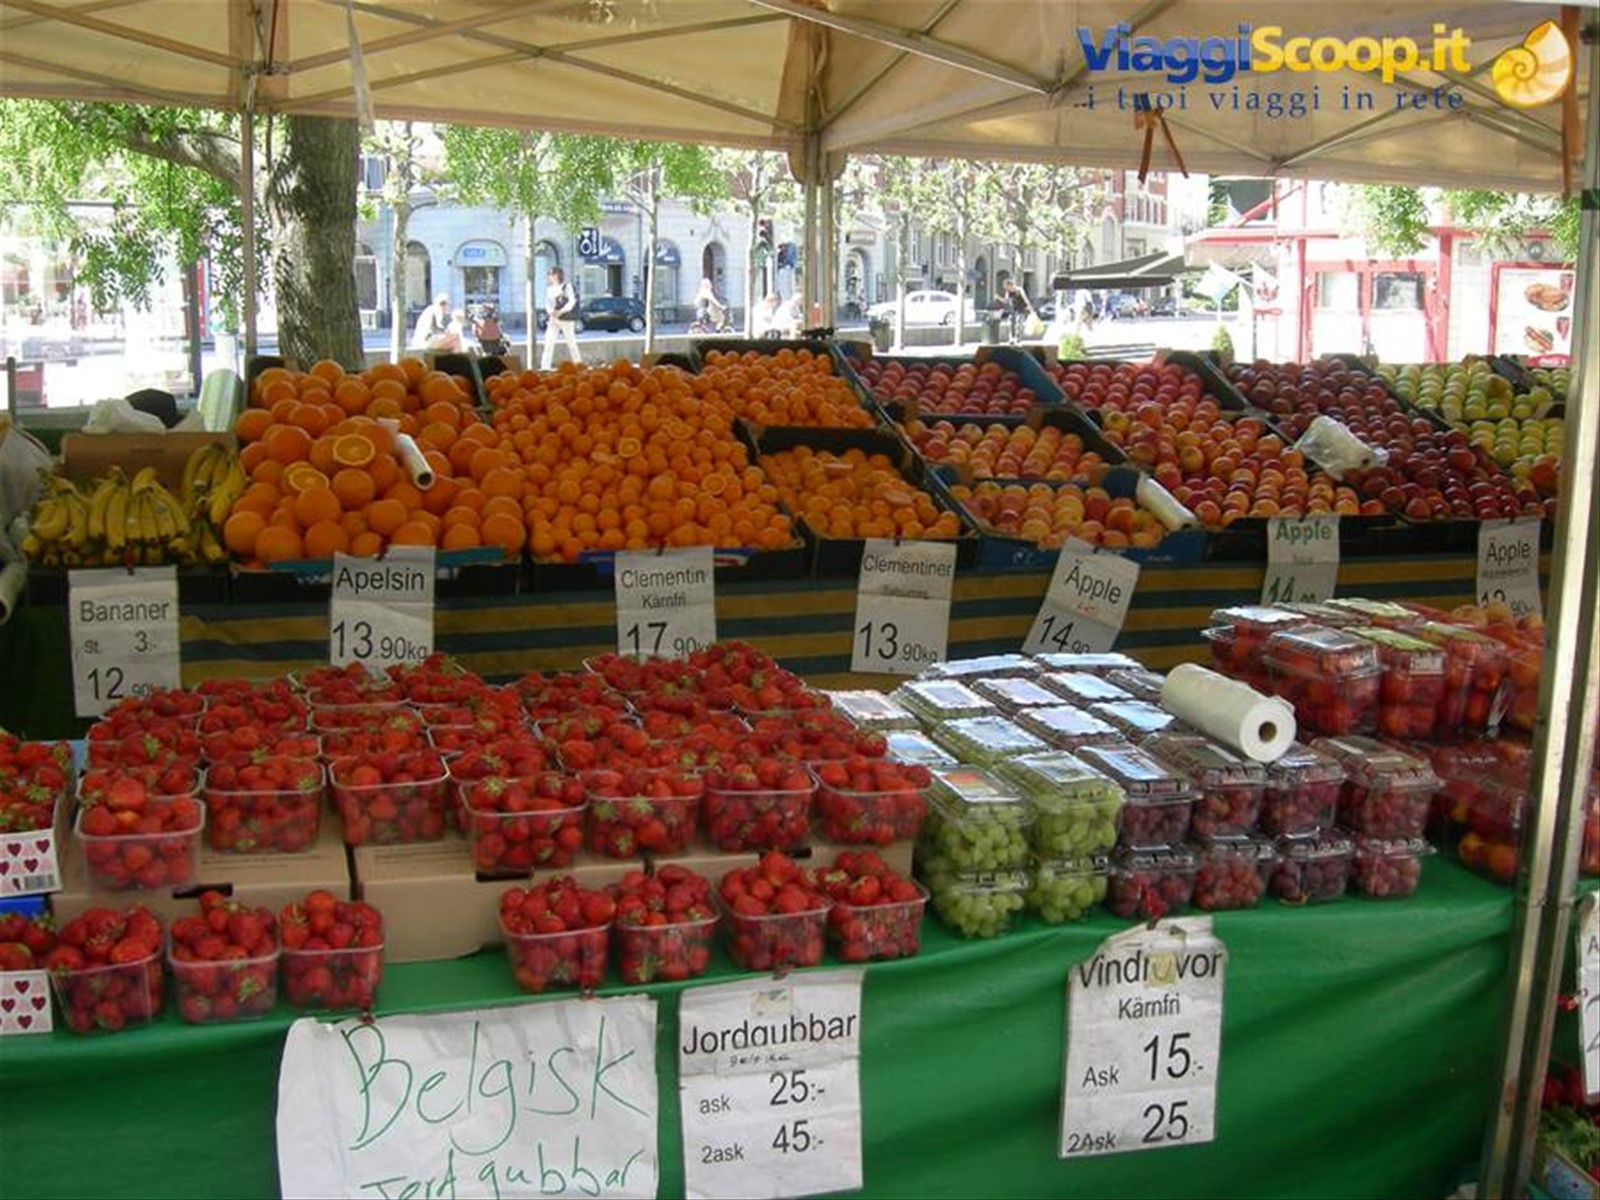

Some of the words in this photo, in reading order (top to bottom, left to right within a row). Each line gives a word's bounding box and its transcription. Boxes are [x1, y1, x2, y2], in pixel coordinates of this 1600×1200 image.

[863, 553, 953, 577] Clementiner
[336, 566, 426, 595] Apelsin
[621, 567, 706, 589] Clementin
[1064, 558, 1122, 604] Äpple
[80, 600, 170, 623] Bananer
[1117, 992, 1181, 1020] Kärnfri
[340, 1014, 650, 1156] Belgisk
[1081, 1066, 1120, 1089] Ask
[699, 1094, 732, 1115] ask
[701, 1143, 745, 1165] 2ask
